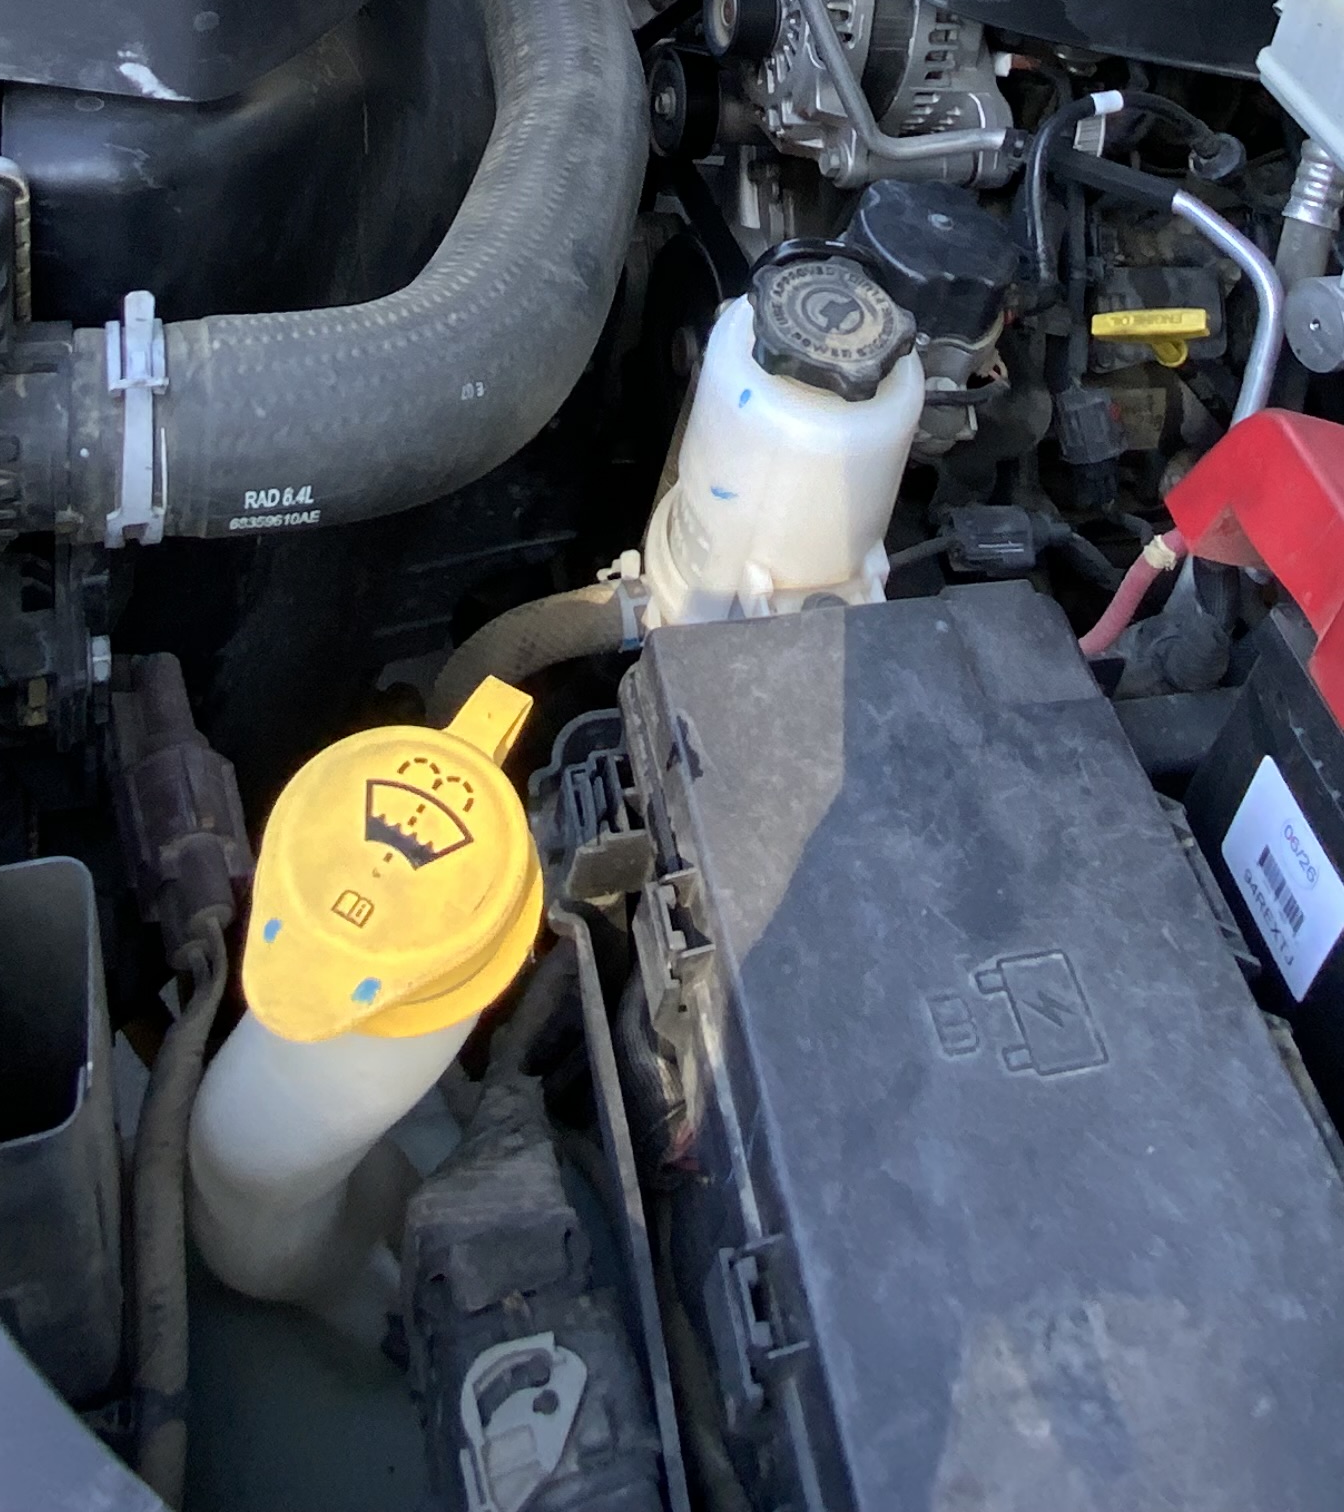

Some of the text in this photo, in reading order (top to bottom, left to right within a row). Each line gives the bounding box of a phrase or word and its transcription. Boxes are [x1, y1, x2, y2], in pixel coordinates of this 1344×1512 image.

[244, 485, 315, 509] RAD 6.4L
[1283, 824, 1318, 884] 06/26
